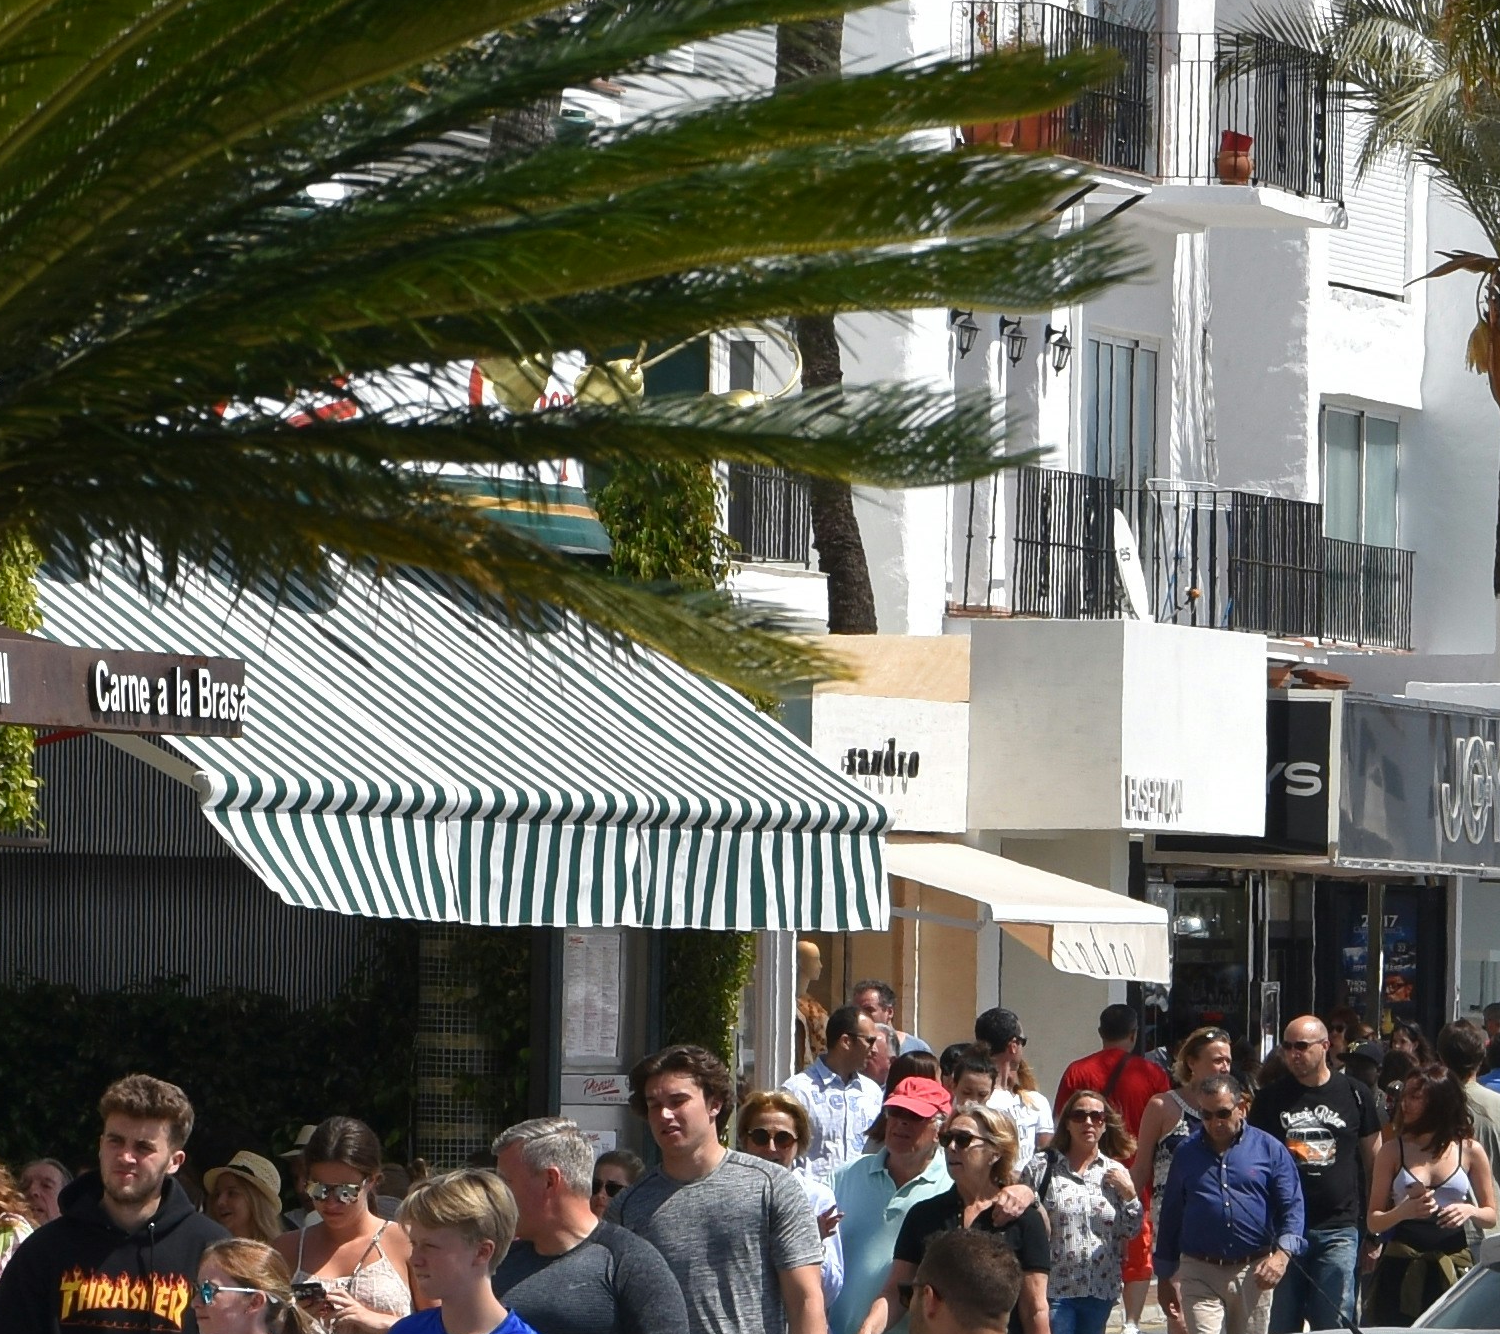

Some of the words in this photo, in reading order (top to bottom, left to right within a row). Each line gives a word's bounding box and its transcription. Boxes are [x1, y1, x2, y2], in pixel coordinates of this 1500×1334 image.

[95, 659, 150, 715] Carne
[157, 677, 169, 716] a
[176, 666, 192, 718] la
[198, 668, 249, 722] Brasa
[60, 1267, 190, 1330] THRASHER
